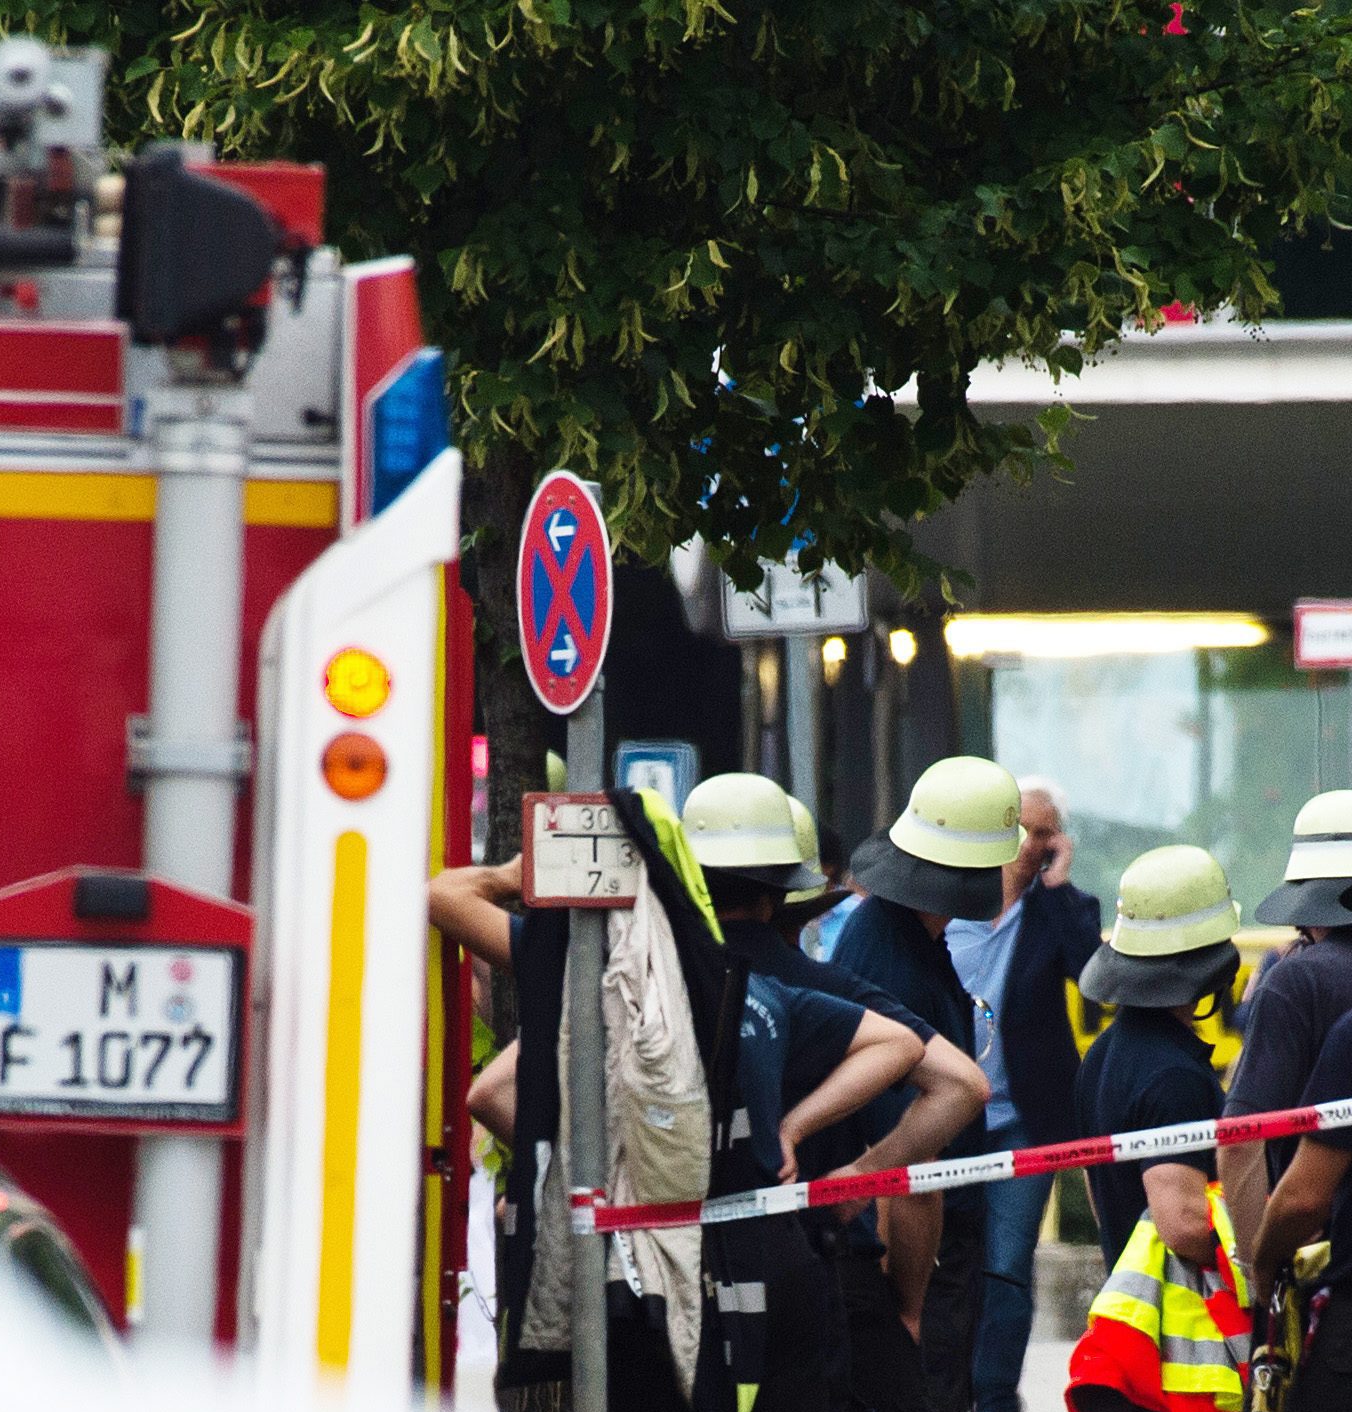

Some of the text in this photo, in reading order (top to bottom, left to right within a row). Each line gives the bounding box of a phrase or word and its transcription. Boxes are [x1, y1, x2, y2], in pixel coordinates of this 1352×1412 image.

[98, 960, 137, 1018] M
[0, 1024, 214, 1090] F 1077
